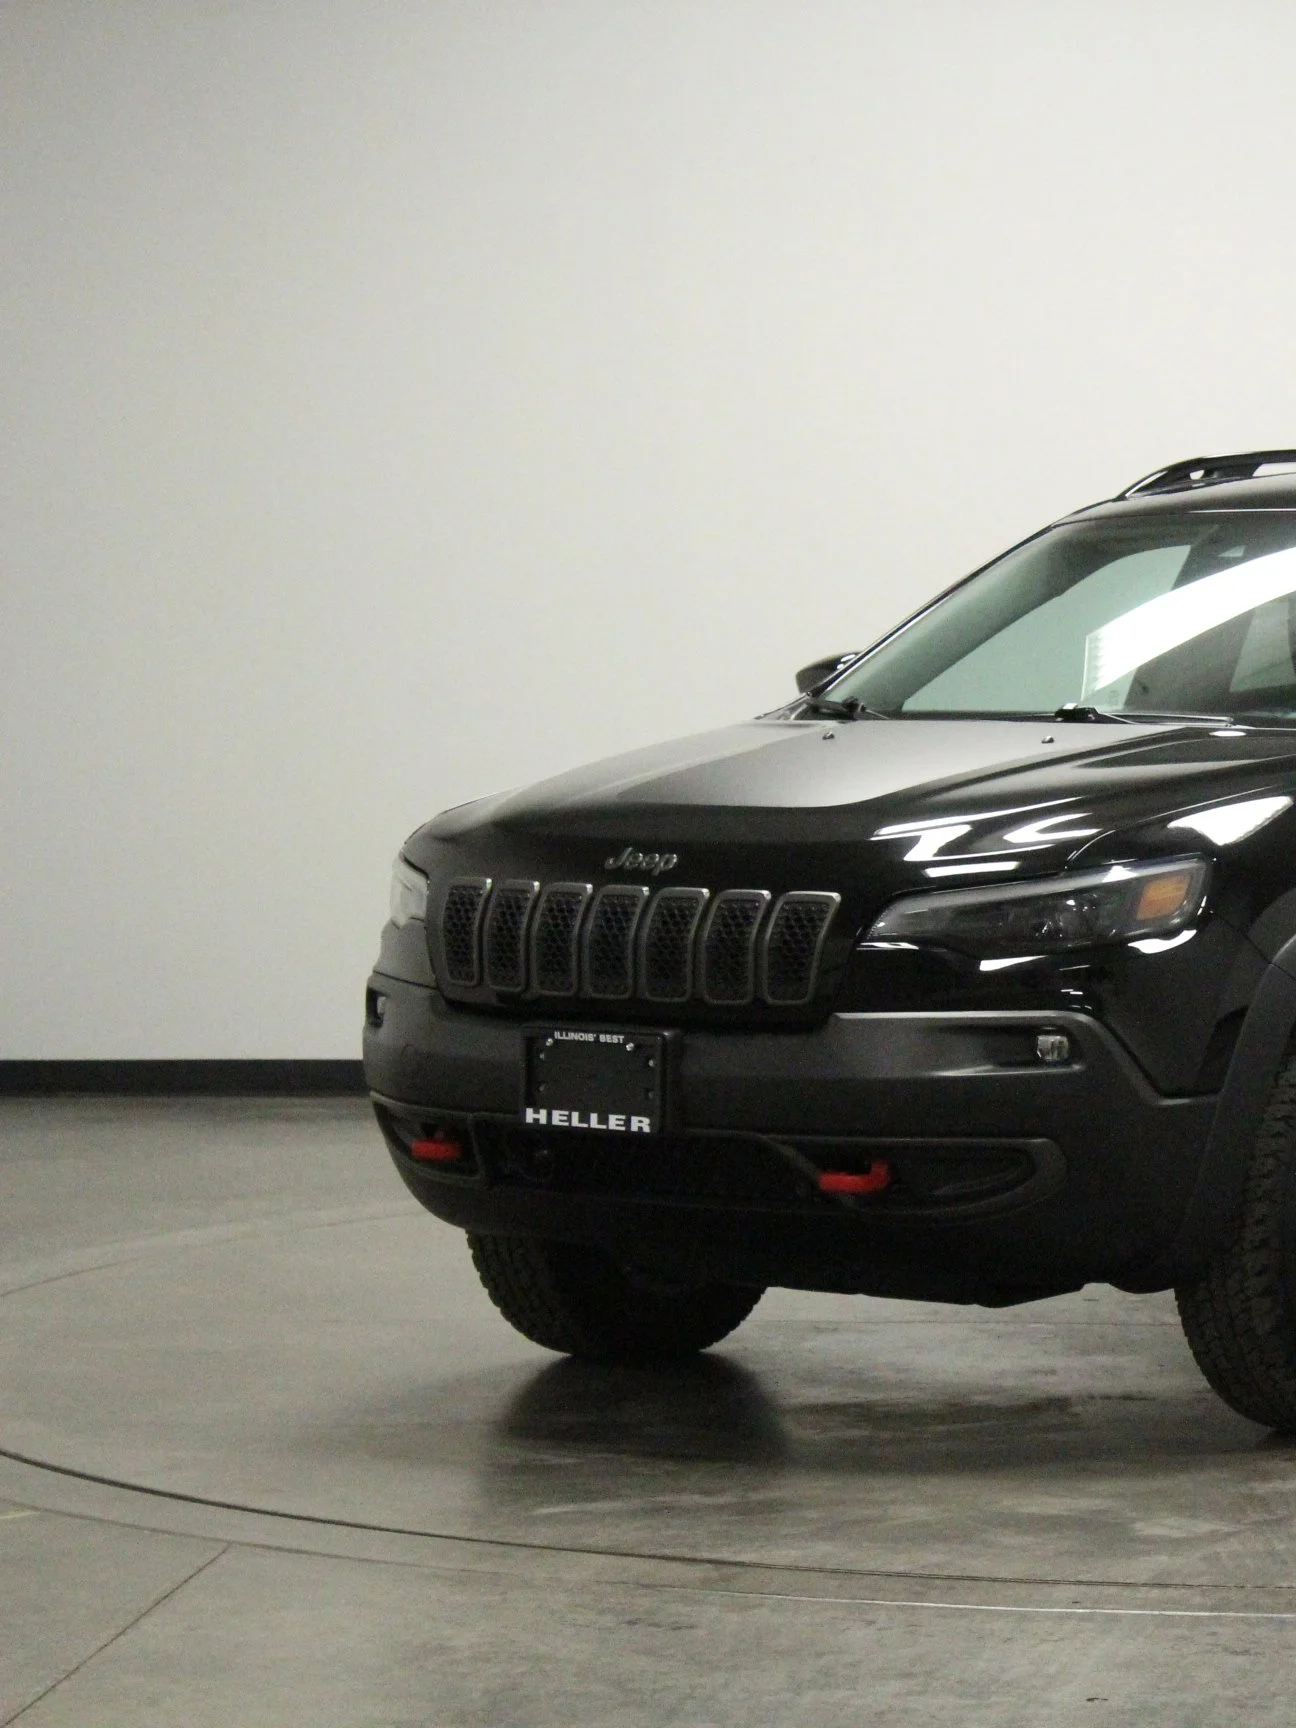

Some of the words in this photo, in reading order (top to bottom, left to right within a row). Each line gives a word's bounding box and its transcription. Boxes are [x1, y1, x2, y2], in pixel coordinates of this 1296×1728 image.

[604, 847, 678, 876] Jeep
[599, 1033, 625, 1044] BEST
[525, 1107, 651, 1133] HELLER
